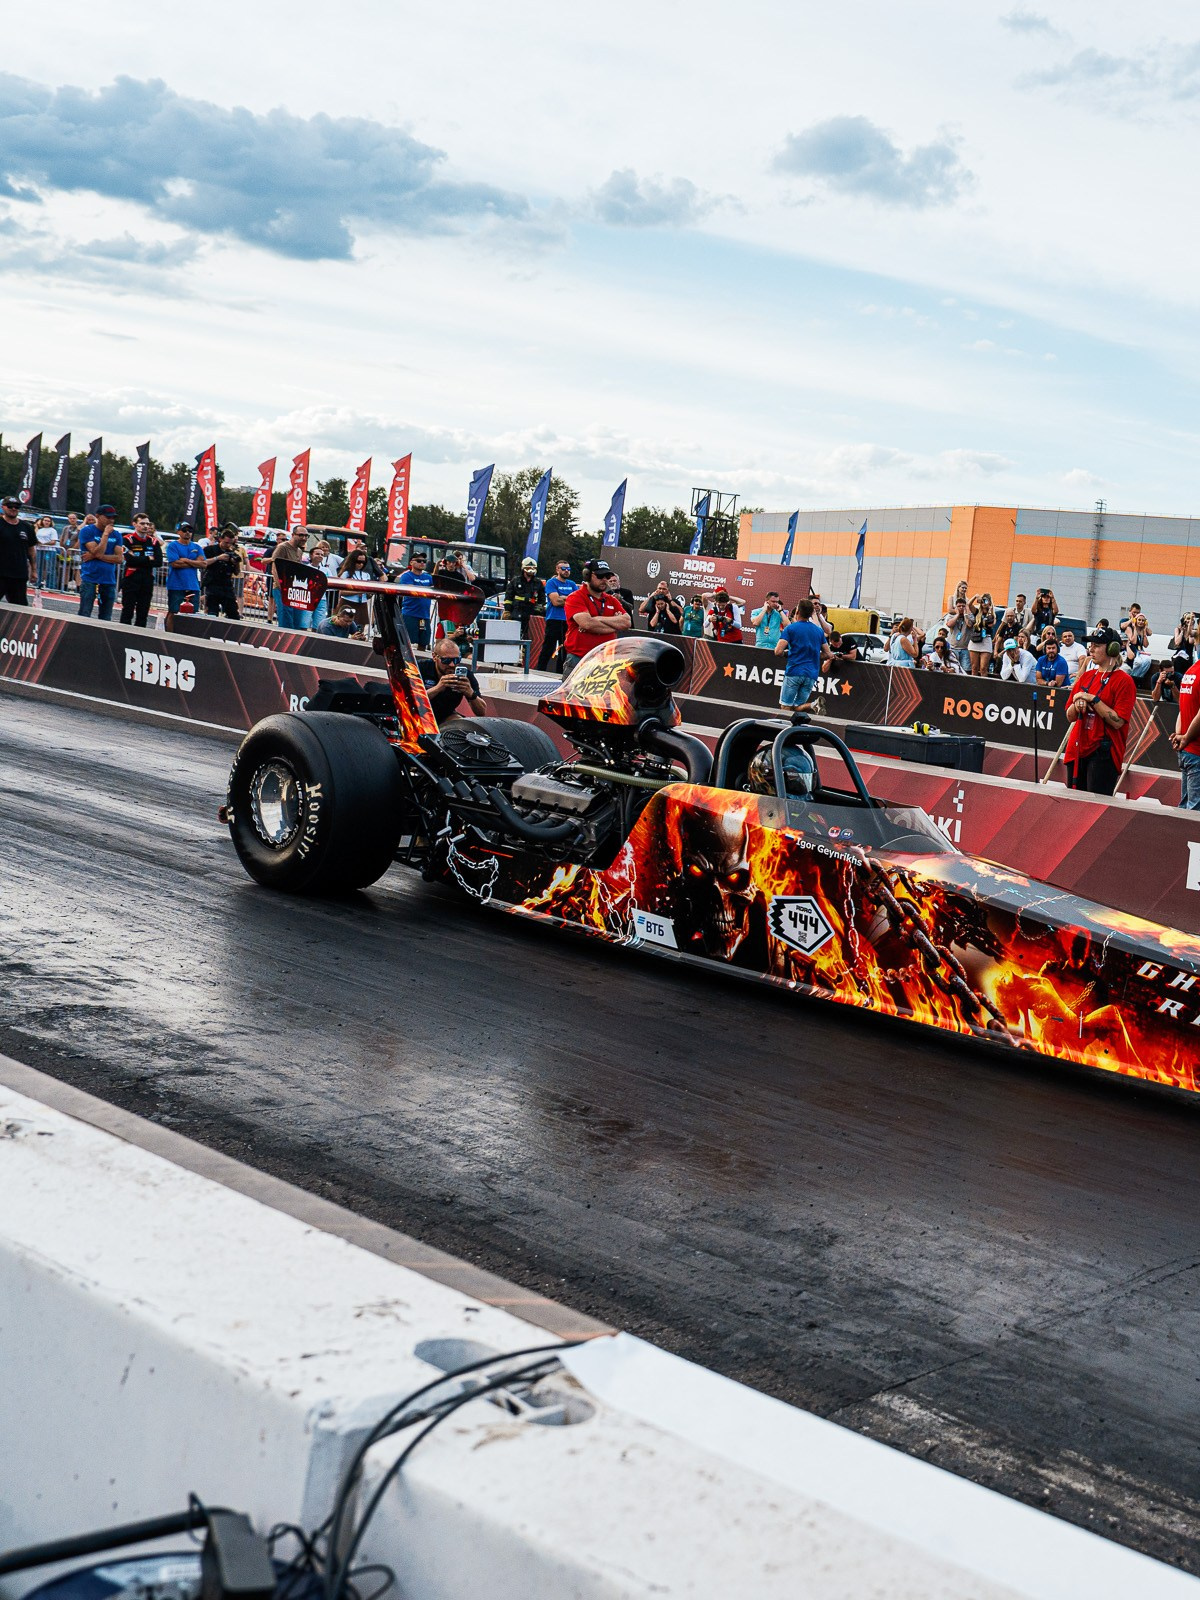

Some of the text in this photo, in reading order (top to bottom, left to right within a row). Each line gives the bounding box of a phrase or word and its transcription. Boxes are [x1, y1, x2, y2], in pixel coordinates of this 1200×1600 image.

[125, 647, 196, 692] RDRC
[735, 664, 840, 696] RACERK
[566, 679, 618, 701] RIDER
[943, 698, 1053, 731] ROSGONKI
[795, 838, 863, 867] Igor Geynrikhs
[645, 920, 665, 937] ВТБ
[788, 910, 819, 935] 444
